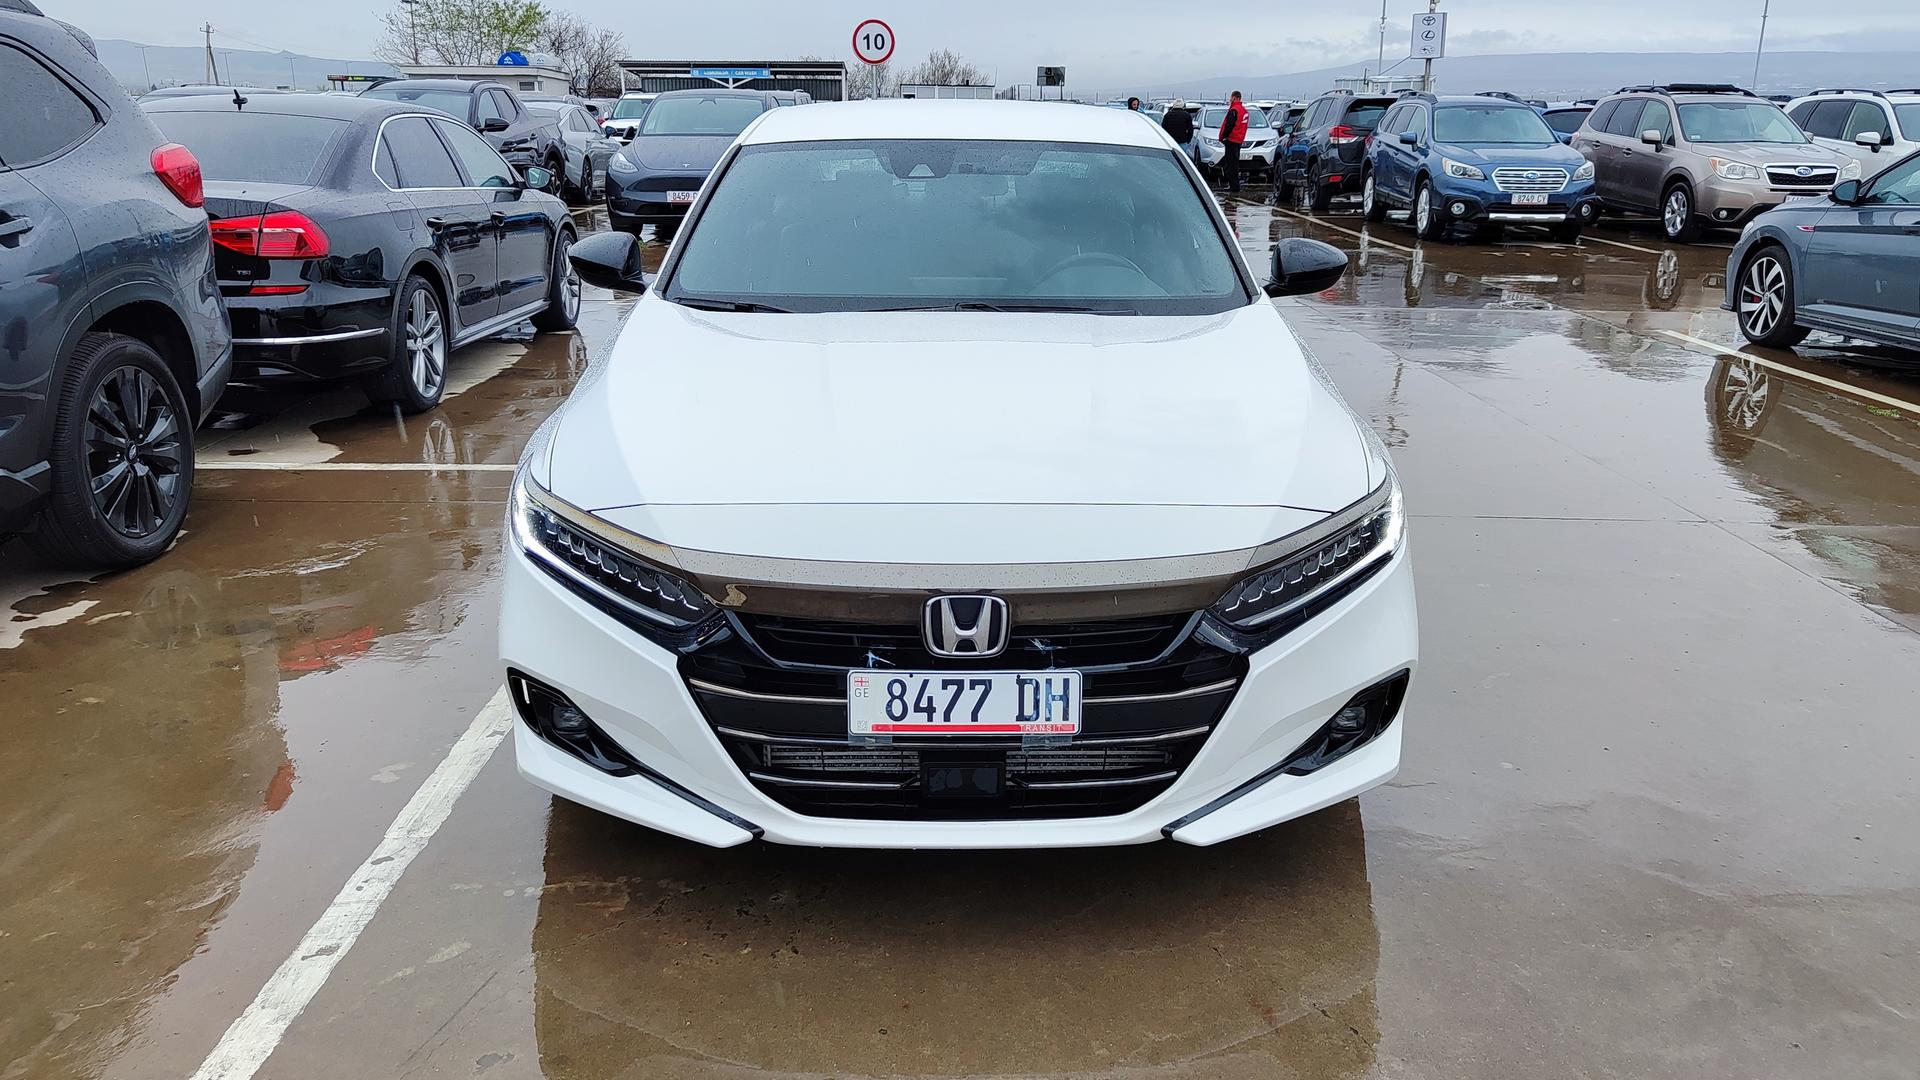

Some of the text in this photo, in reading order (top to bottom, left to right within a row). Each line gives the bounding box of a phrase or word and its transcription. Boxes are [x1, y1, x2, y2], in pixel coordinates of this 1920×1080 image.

[862, 33, 885, 50] 10
[672, 192, 690, 201] 8459
[854, 687, 869, 698] GE
[885, 677, 1070, 722] 8477 DH
[1020, 724, 1063, 732] TRANSIT
